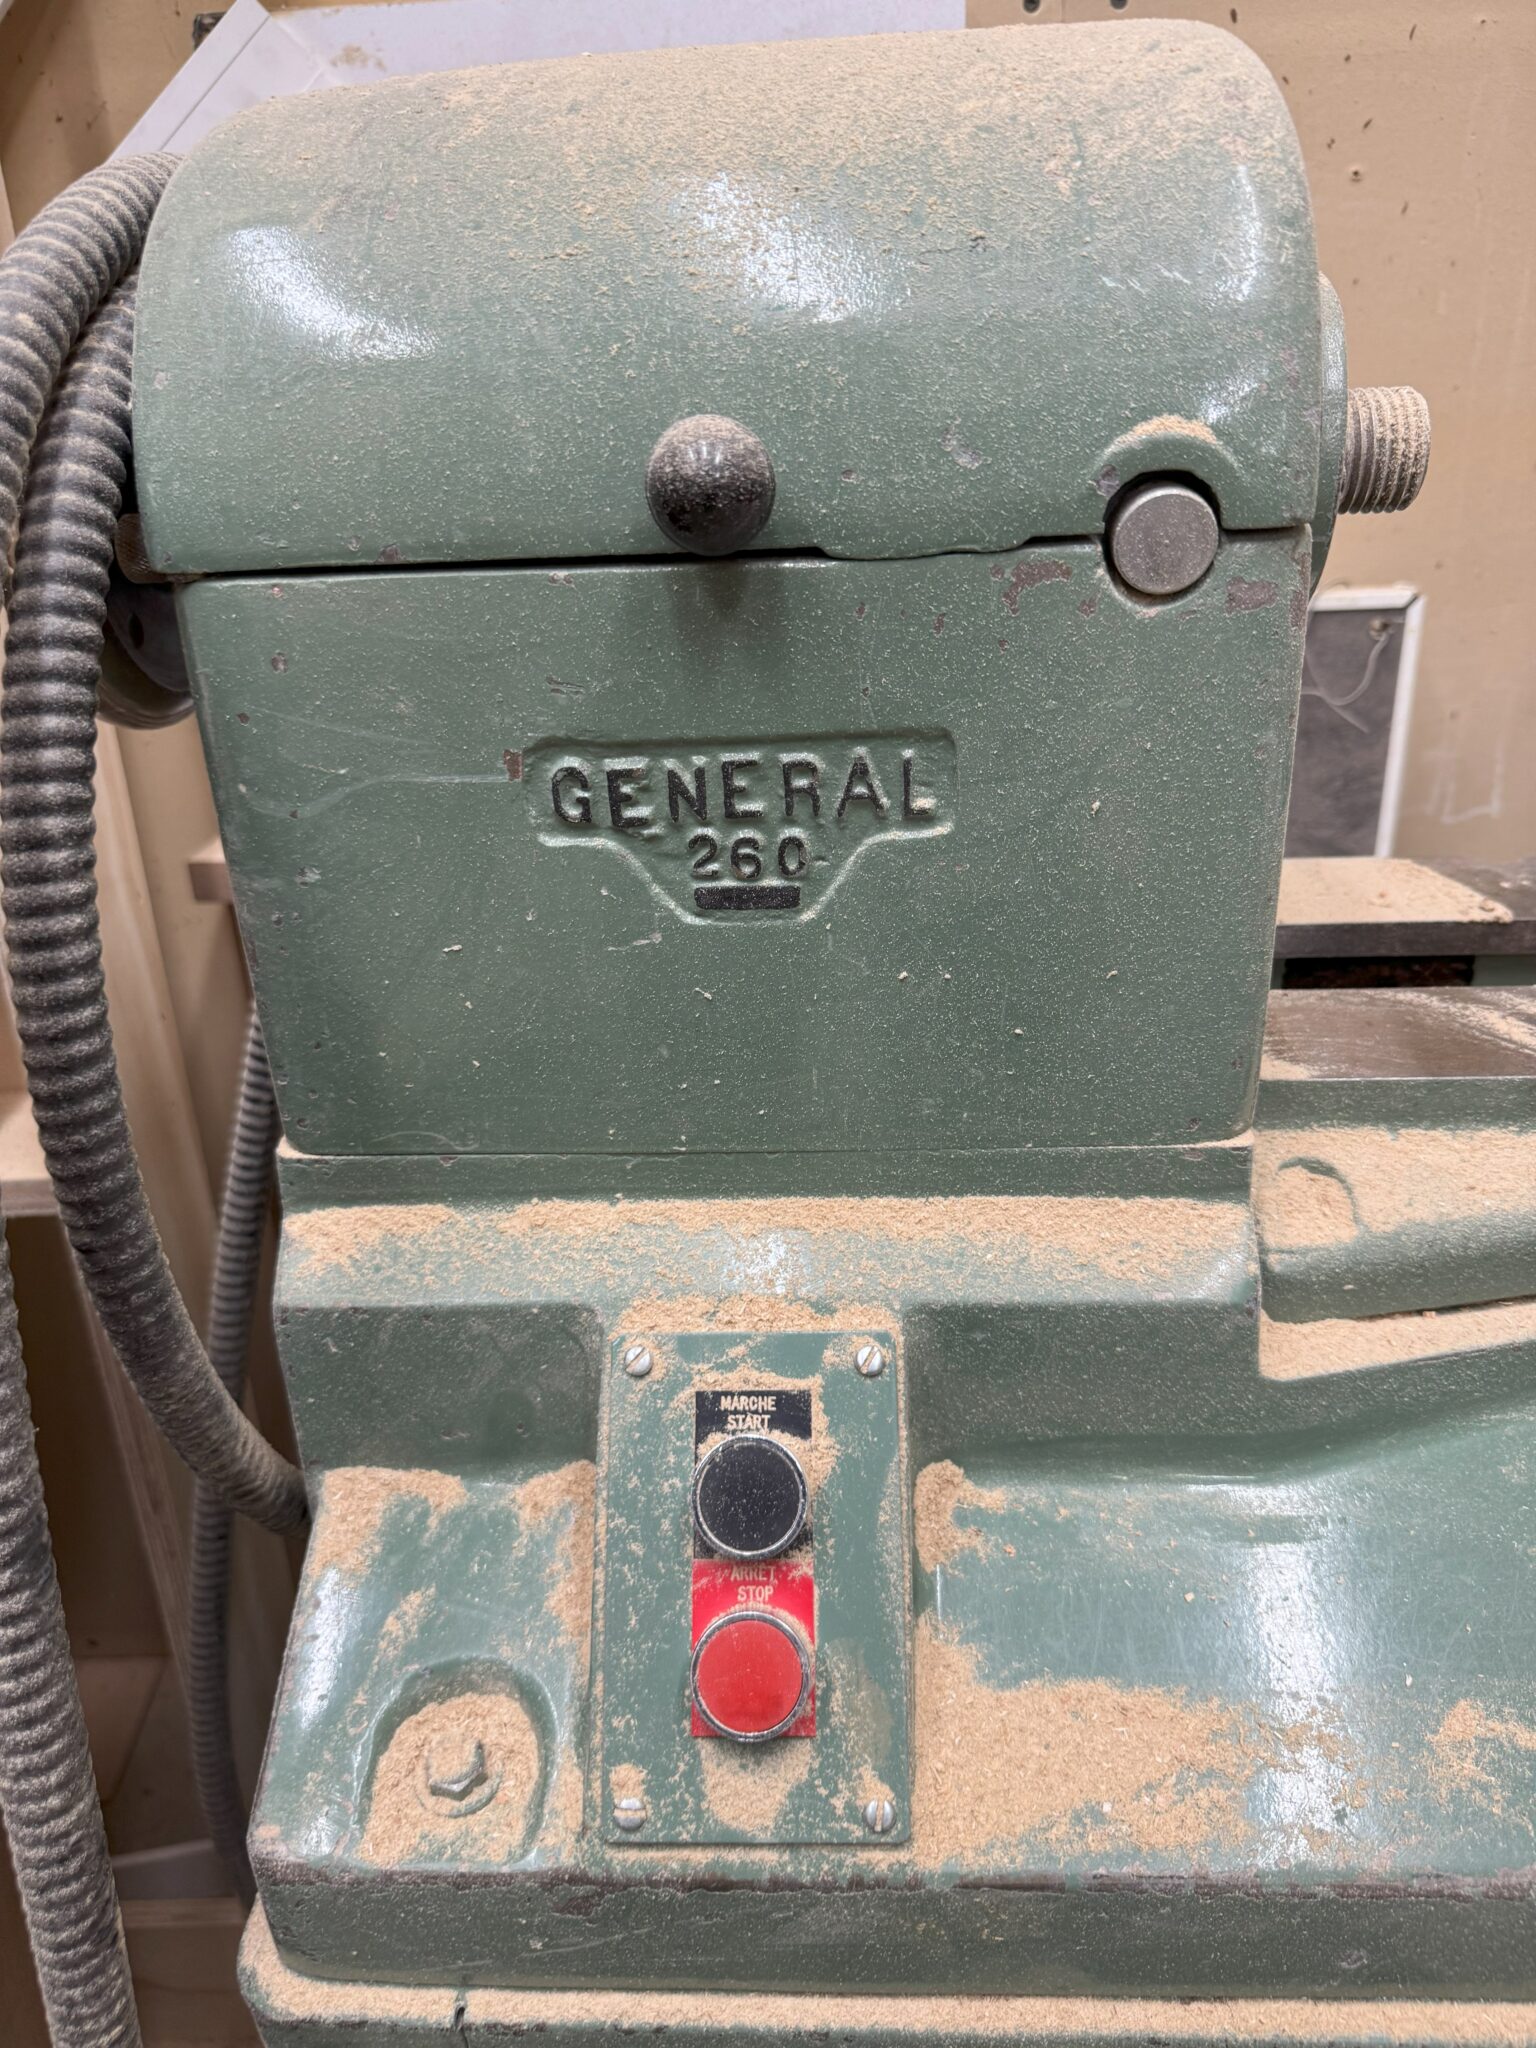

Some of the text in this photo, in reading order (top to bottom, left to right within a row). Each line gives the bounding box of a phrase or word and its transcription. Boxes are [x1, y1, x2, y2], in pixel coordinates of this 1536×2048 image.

[550, 748, 937, 828] GENERAL
[687, 827, 807, 880] 260
[720, 1395, 777, 1411] MARCHE
[727, 1414, 771, 1431] START
[737, 1585, 774, 1602] STOP
